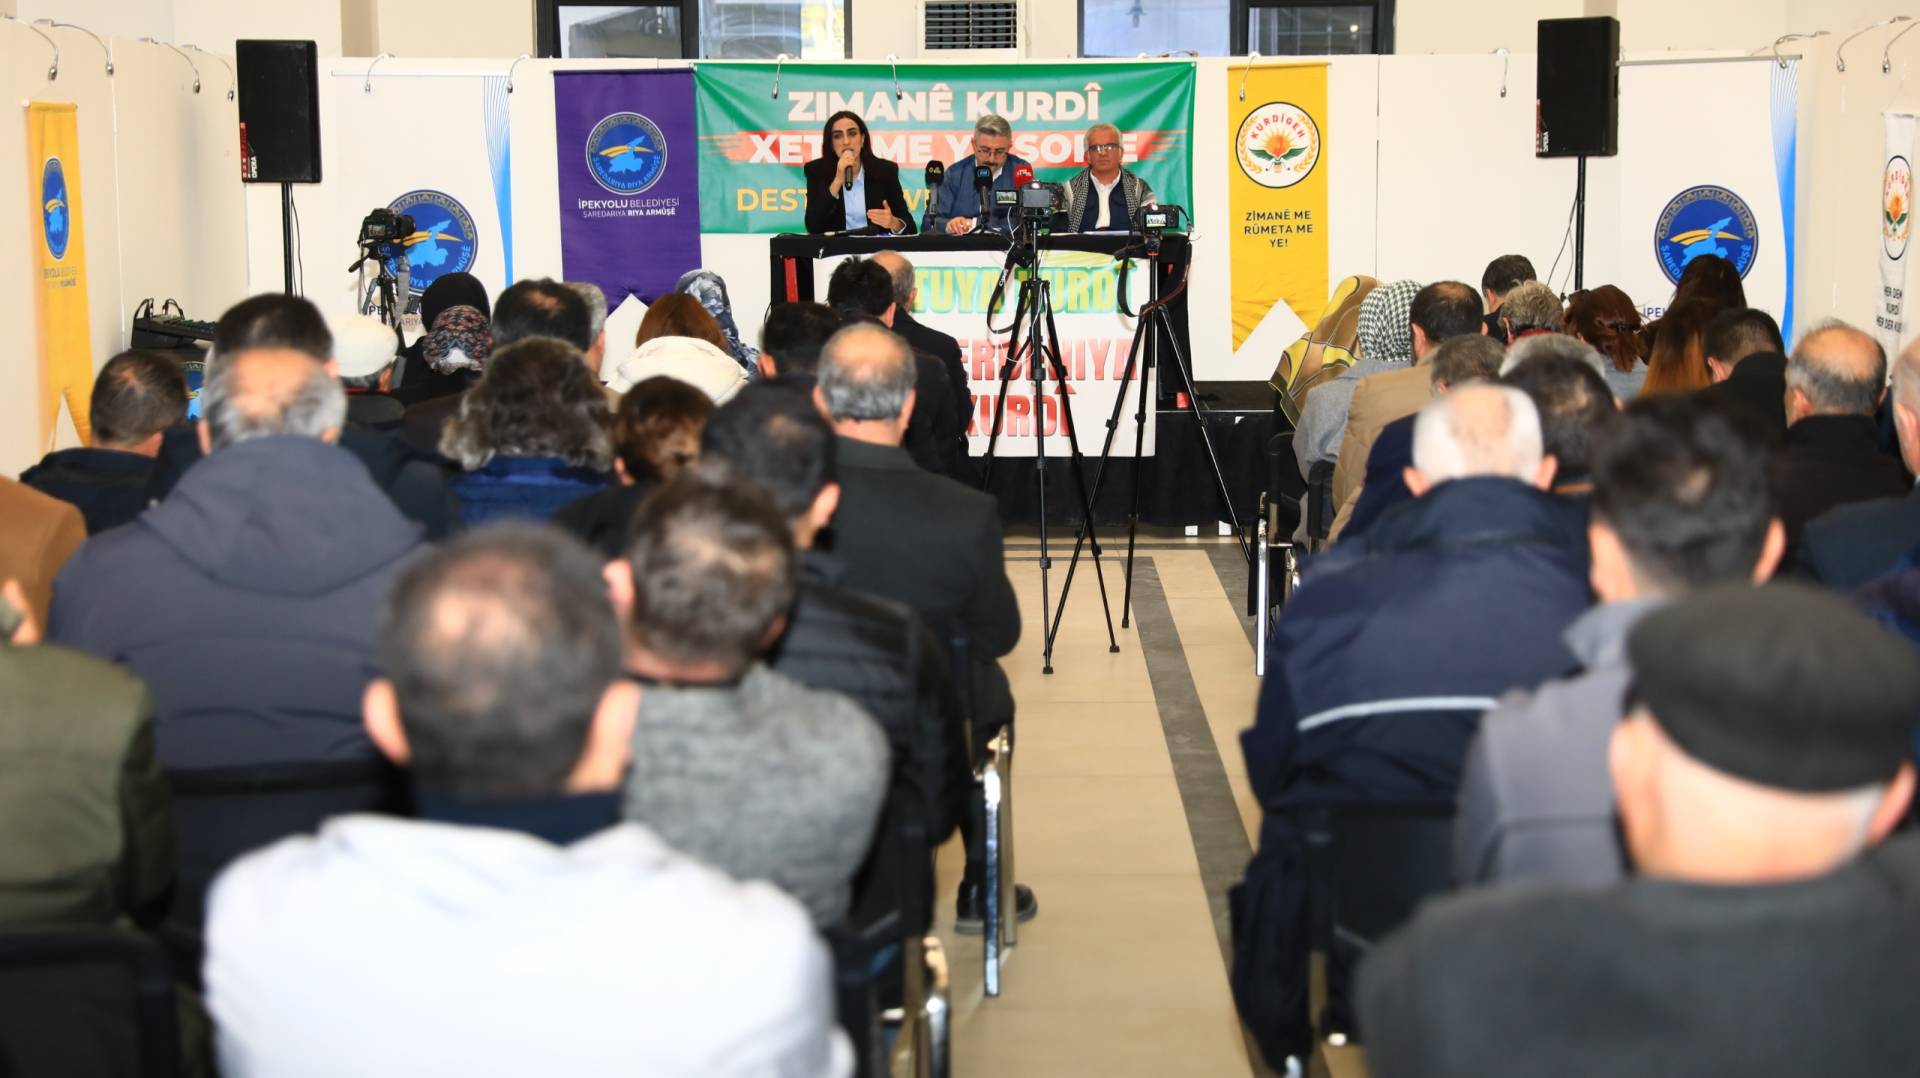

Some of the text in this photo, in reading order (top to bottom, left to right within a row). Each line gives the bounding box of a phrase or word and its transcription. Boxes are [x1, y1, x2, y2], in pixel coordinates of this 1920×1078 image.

[786, 82, 1102, 122] ZIMANÊ KURDÎ
[750, 134, 823, 164] XET
[872, 134, 933, 164] ME
[1014, 133, 1085, 164] SO
[578, 198, 628, 209] İPEKYOLU
[1294, 210, 1312, 220] ME
[1296, 224, 1314, 234] ME
[1269, 238, 1288, 248] YE!
